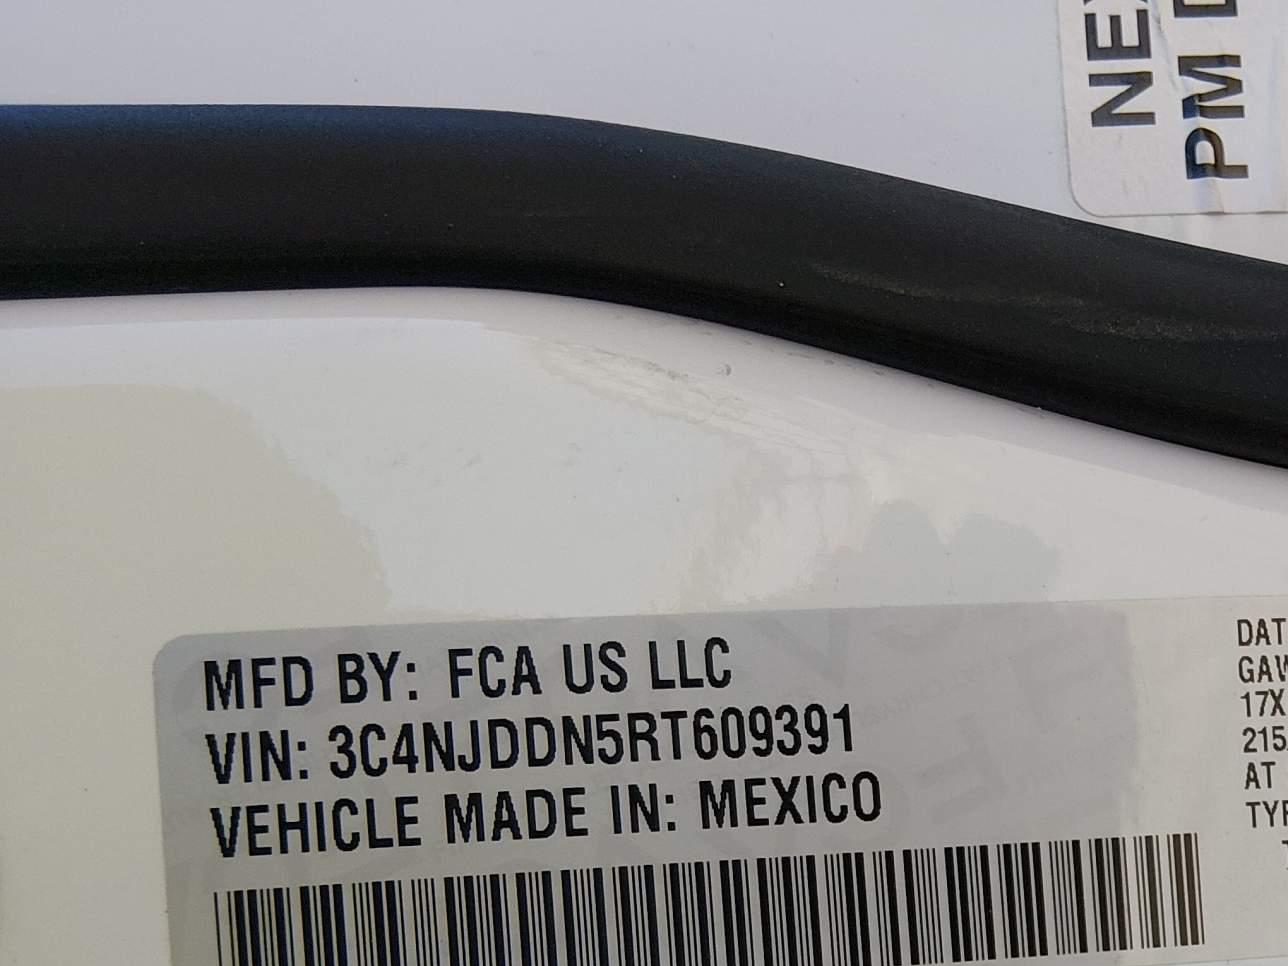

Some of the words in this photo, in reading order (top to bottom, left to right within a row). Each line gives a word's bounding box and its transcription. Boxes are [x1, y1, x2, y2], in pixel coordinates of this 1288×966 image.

[1084, 0, 1156, 127] NE
[1178, 54, 1249, 180] PM
[204, 656, 313, 711] MFD
[338, 651, 417, 703] BY:
[448, 646, 542, 698] FCA
[563, 641, 628, 694] US
[649, 637, 731, 689] LLC
[205, 730, 308, 784] VIN:
[328, 703, 854, 780] 3C4NJDDN5RT609391
[1245, 761, 1276, 789] AT
[210, 796, 421, 857] VEHICLE
[444, 787, 588, 844] MADE
[610, 783, 676, 834] IN:
[699, 771, 881, 829] MEXICO
